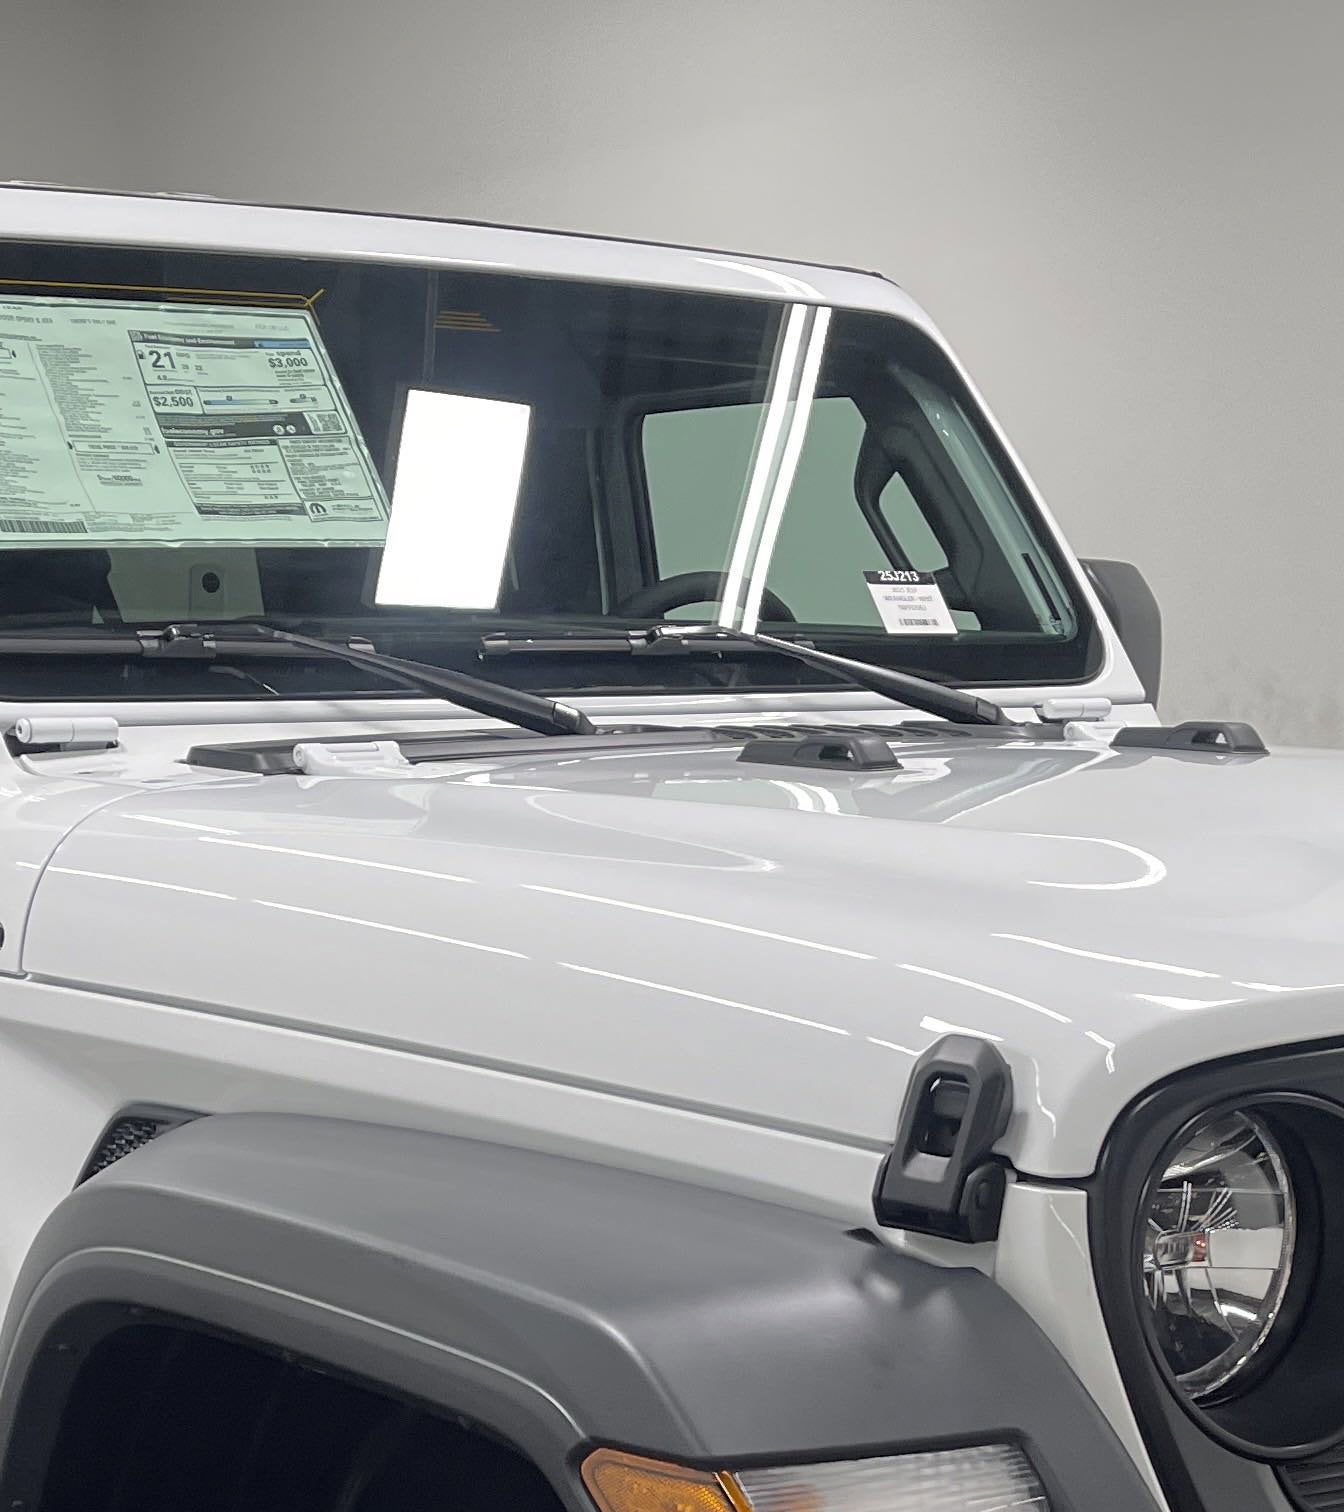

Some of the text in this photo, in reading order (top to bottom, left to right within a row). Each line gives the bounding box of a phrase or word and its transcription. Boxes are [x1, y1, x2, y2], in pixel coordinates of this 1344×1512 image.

[149, 350, 176, 369] 21
[268, 357, 308, 368] $3,000
[152, 396, 194, 408] $2,500
[877, 570, 920, 582] 25J213
